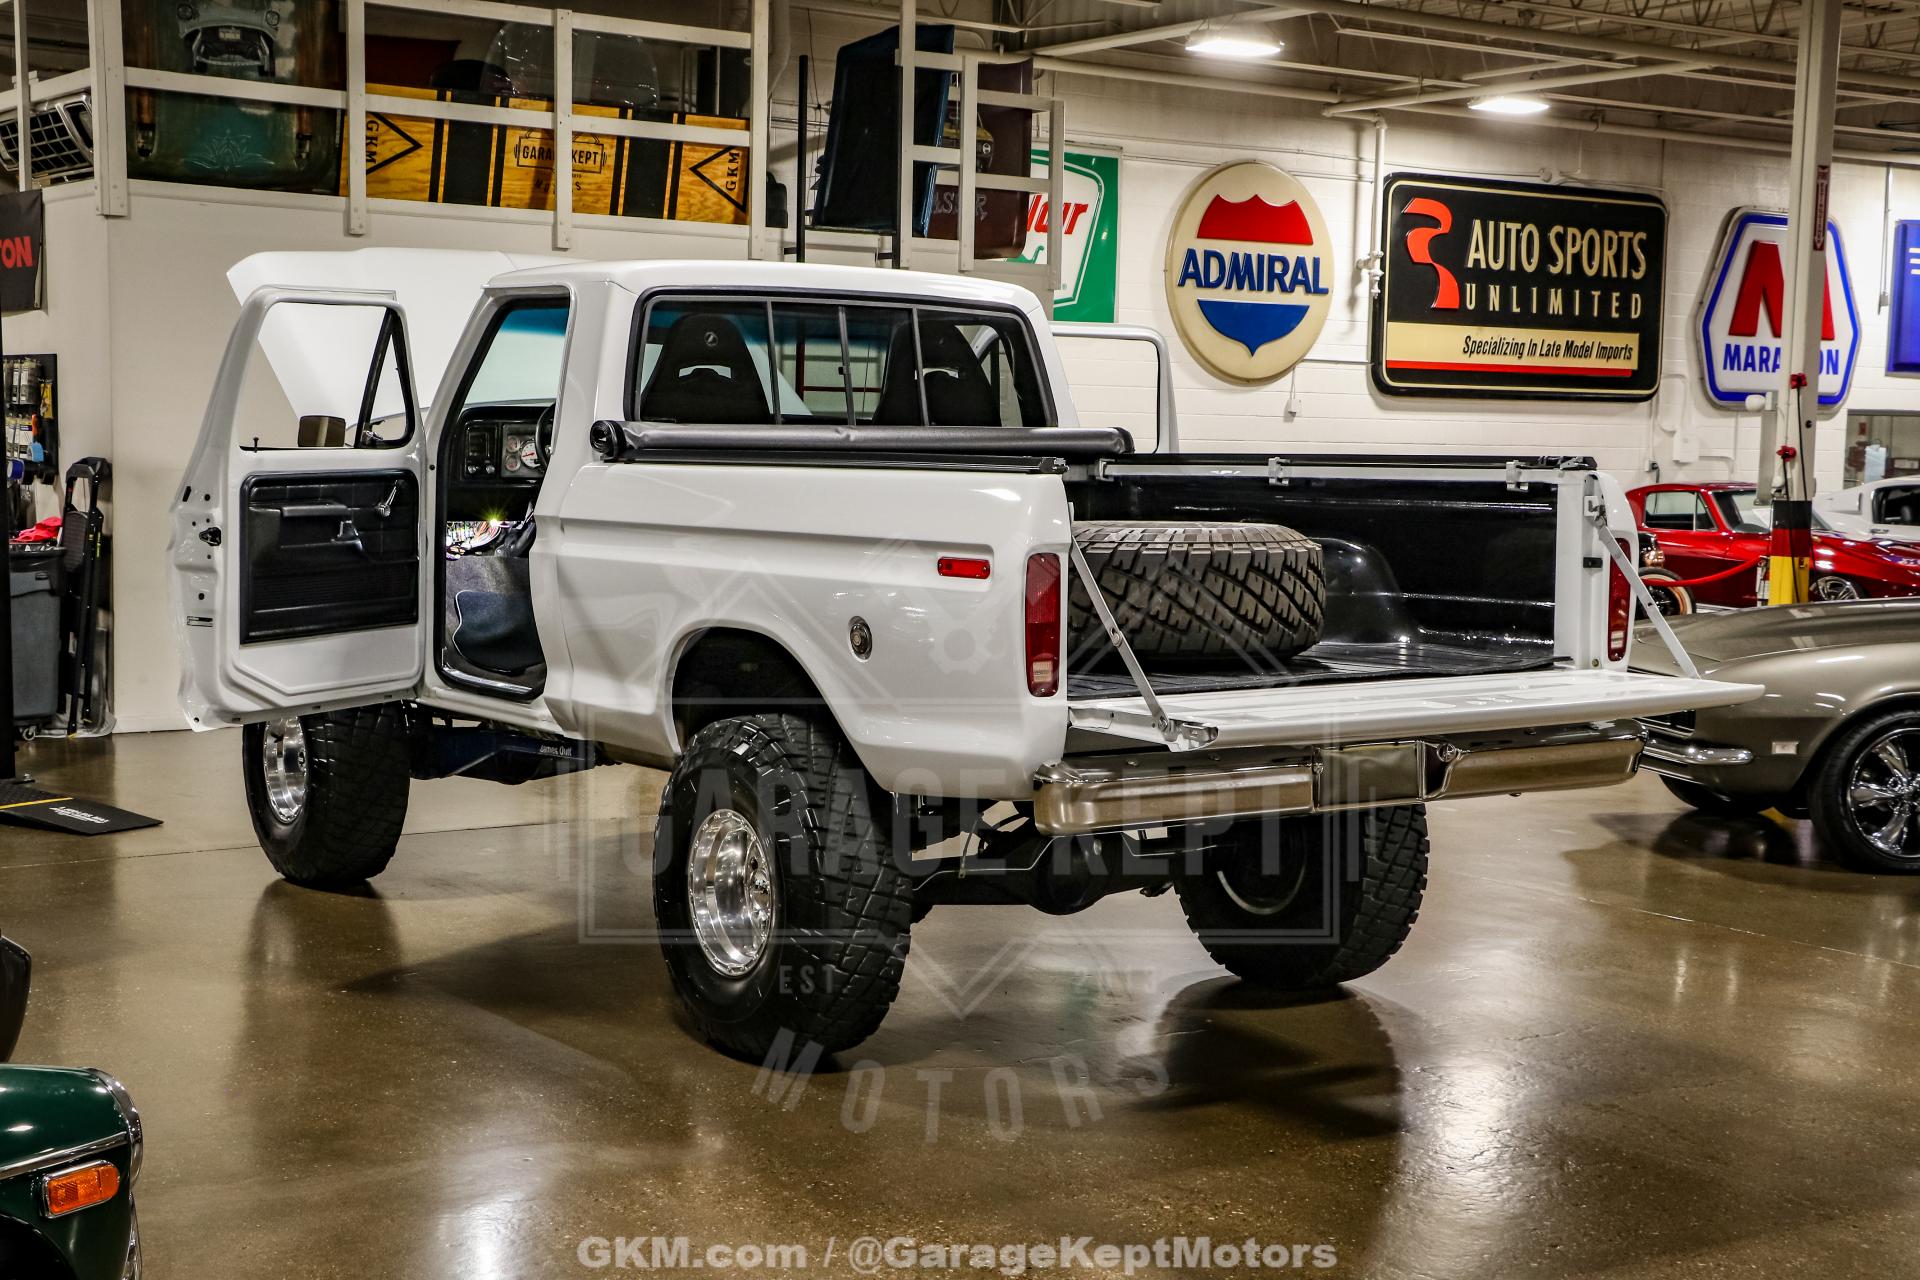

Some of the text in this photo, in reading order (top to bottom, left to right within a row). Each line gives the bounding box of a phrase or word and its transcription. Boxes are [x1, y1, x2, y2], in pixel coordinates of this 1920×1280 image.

[522, 145, 554, 161] GARA
[725, 152, 741, 191] GKM
[0, 235, 34, 269] ON
[1466, 218, 1647, 280] AUTO SPORTS
[1177, 247, 1329, 295] ADMIRAL
[1465, 282, 1642, 320] UNLIMITED
[1462, 335, 1633, 362] Specializing In Late Model Imports
[1722, 343, 1840, 376] MARAON
